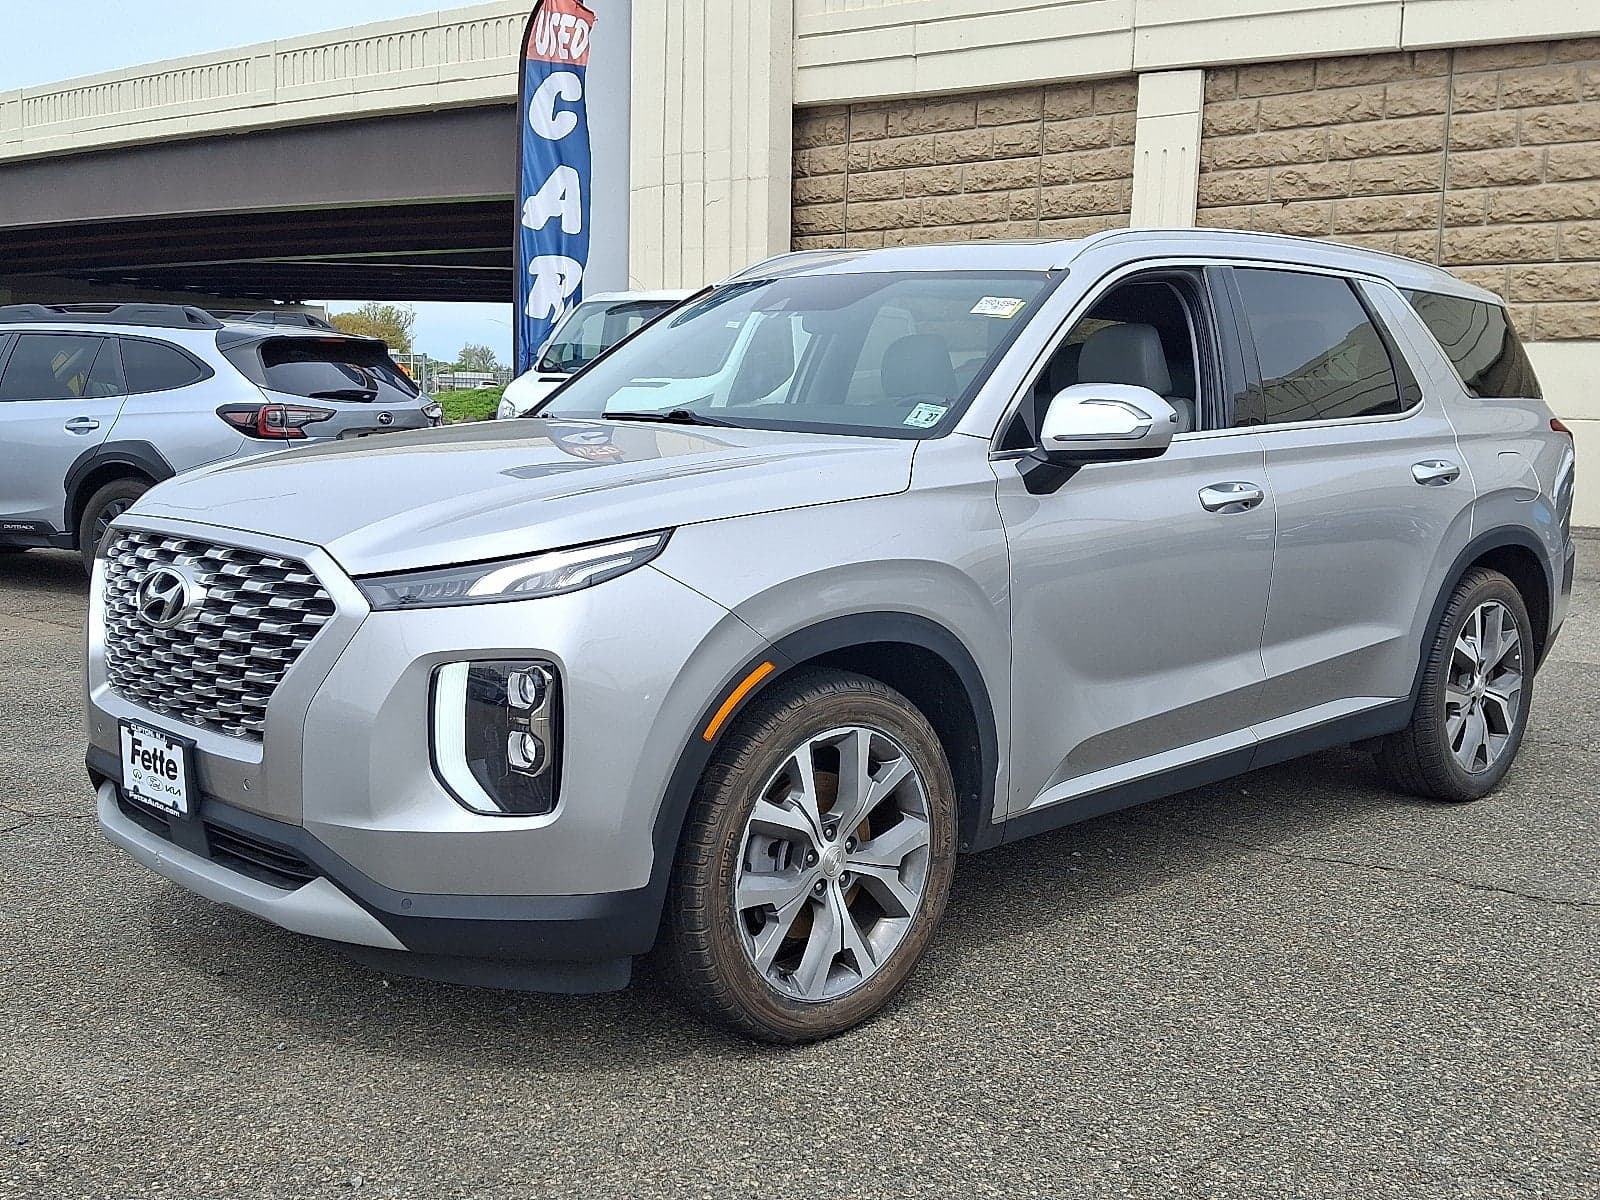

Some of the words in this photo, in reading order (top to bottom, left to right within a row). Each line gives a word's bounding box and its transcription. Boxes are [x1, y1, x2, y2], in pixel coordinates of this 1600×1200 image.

[535, 10, 589, 59] USED
[522, 71, 583, 323] CAR
[131, 737, 178, 780] Fette
